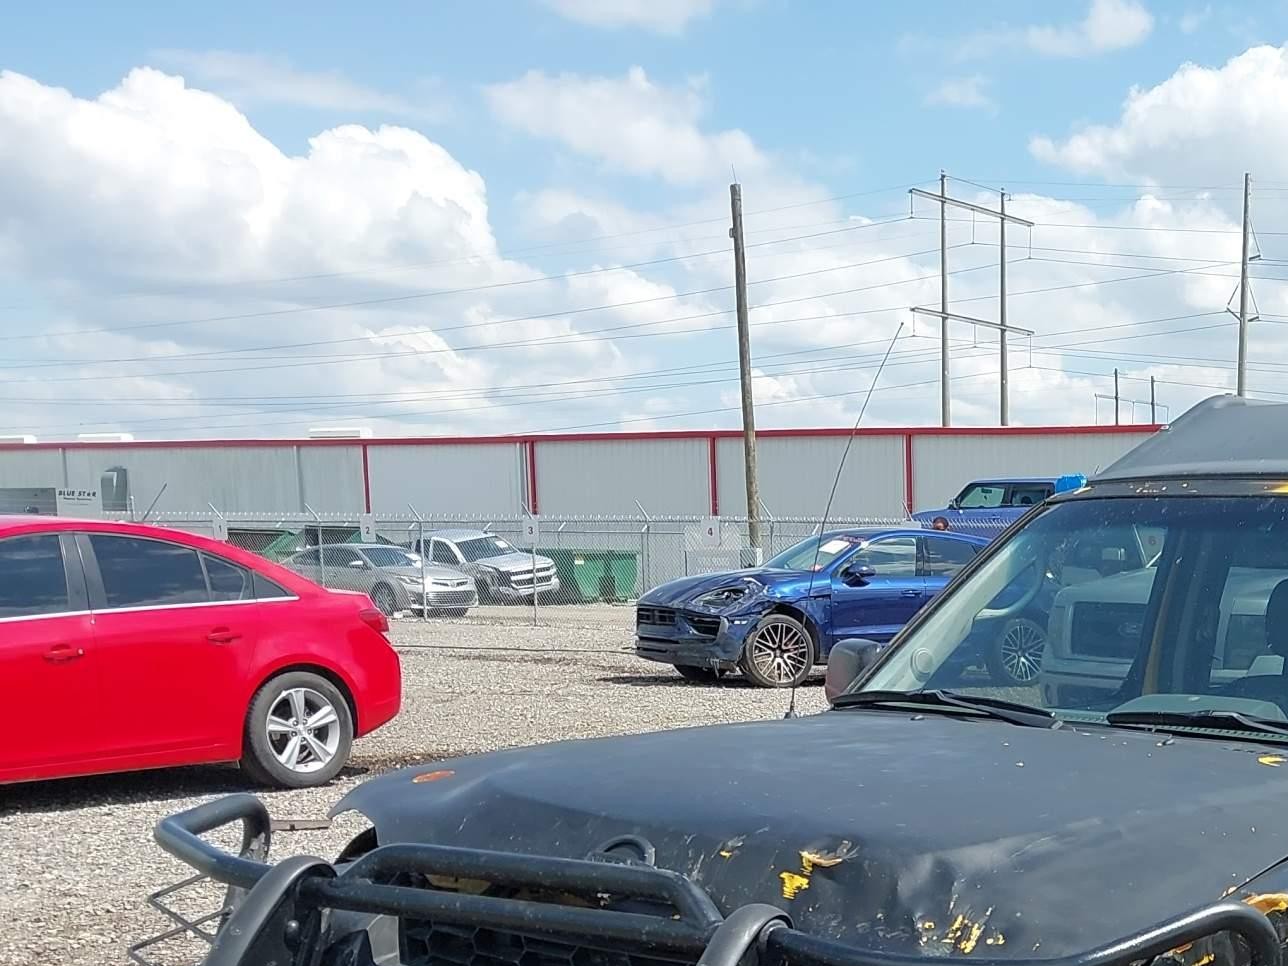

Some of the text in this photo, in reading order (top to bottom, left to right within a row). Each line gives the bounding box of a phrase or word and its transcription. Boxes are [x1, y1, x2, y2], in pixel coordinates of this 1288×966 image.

[365, 526, 371, 535] 2
[527, 526, 534, 535] 3
[707, 527, 713, 537] 4
